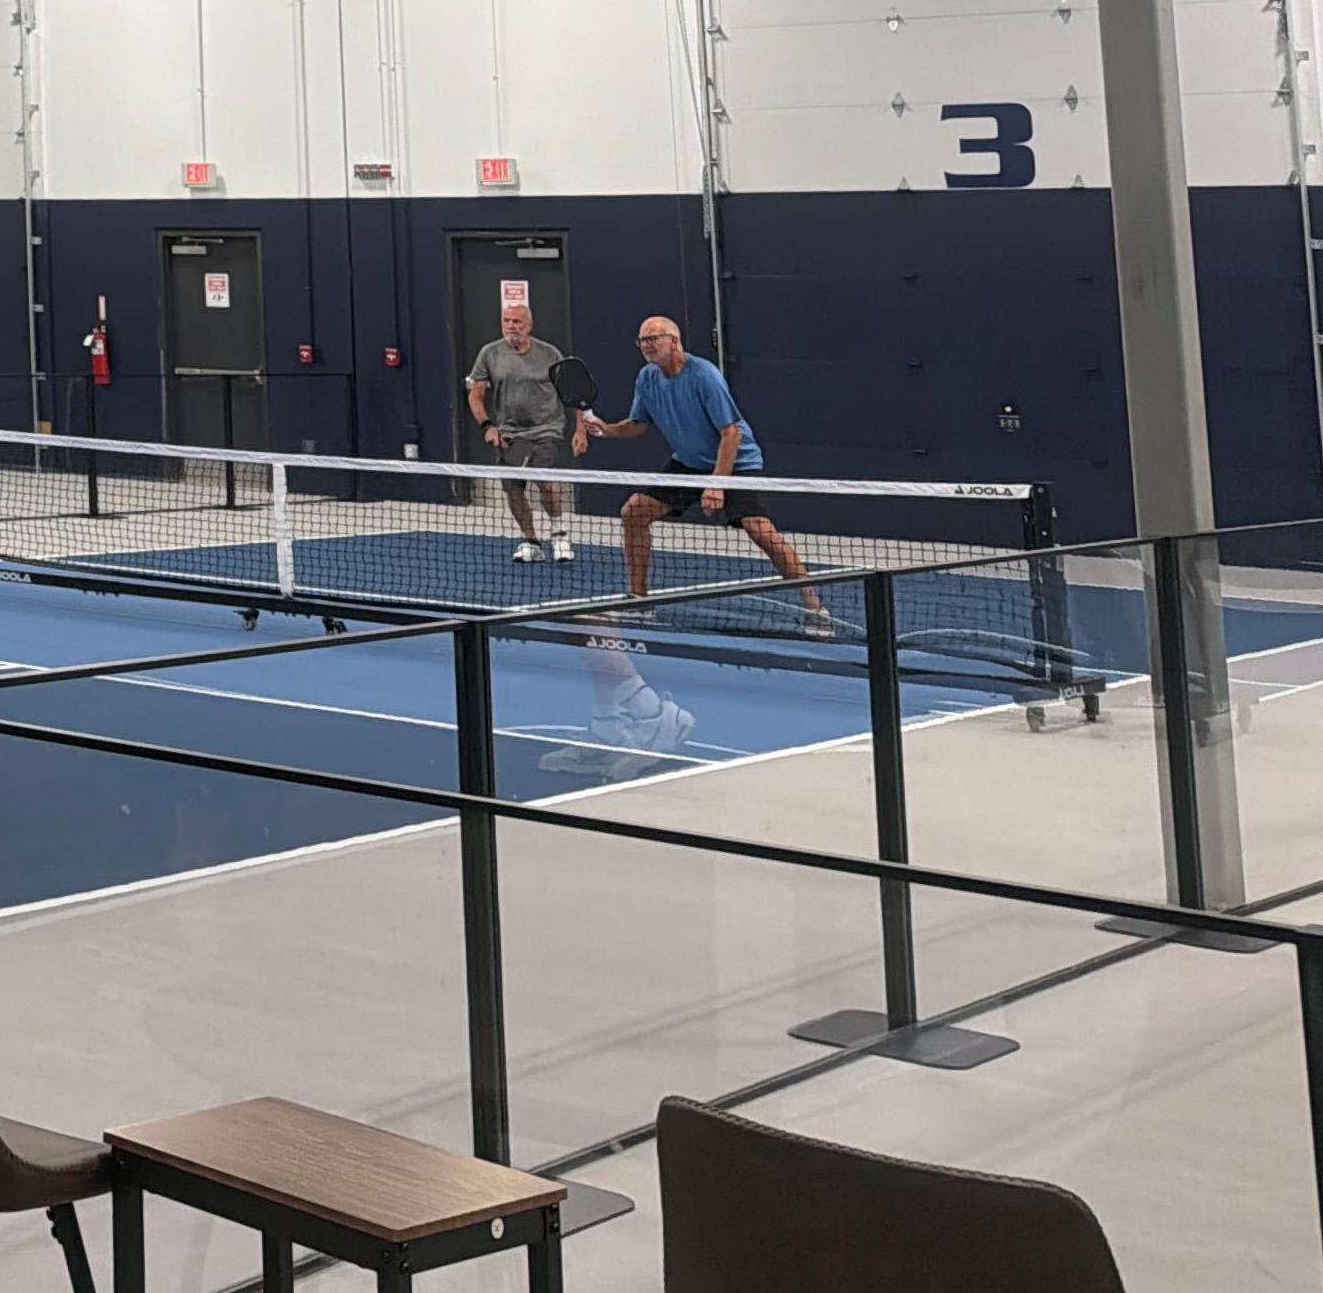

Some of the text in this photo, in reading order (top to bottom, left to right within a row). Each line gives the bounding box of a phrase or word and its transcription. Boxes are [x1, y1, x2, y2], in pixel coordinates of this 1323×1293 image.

[940, 102, 1036, 188] 3
[967, 486, 1013, 496] JOOLA
[599, 637, 648, 654] JOOLA
